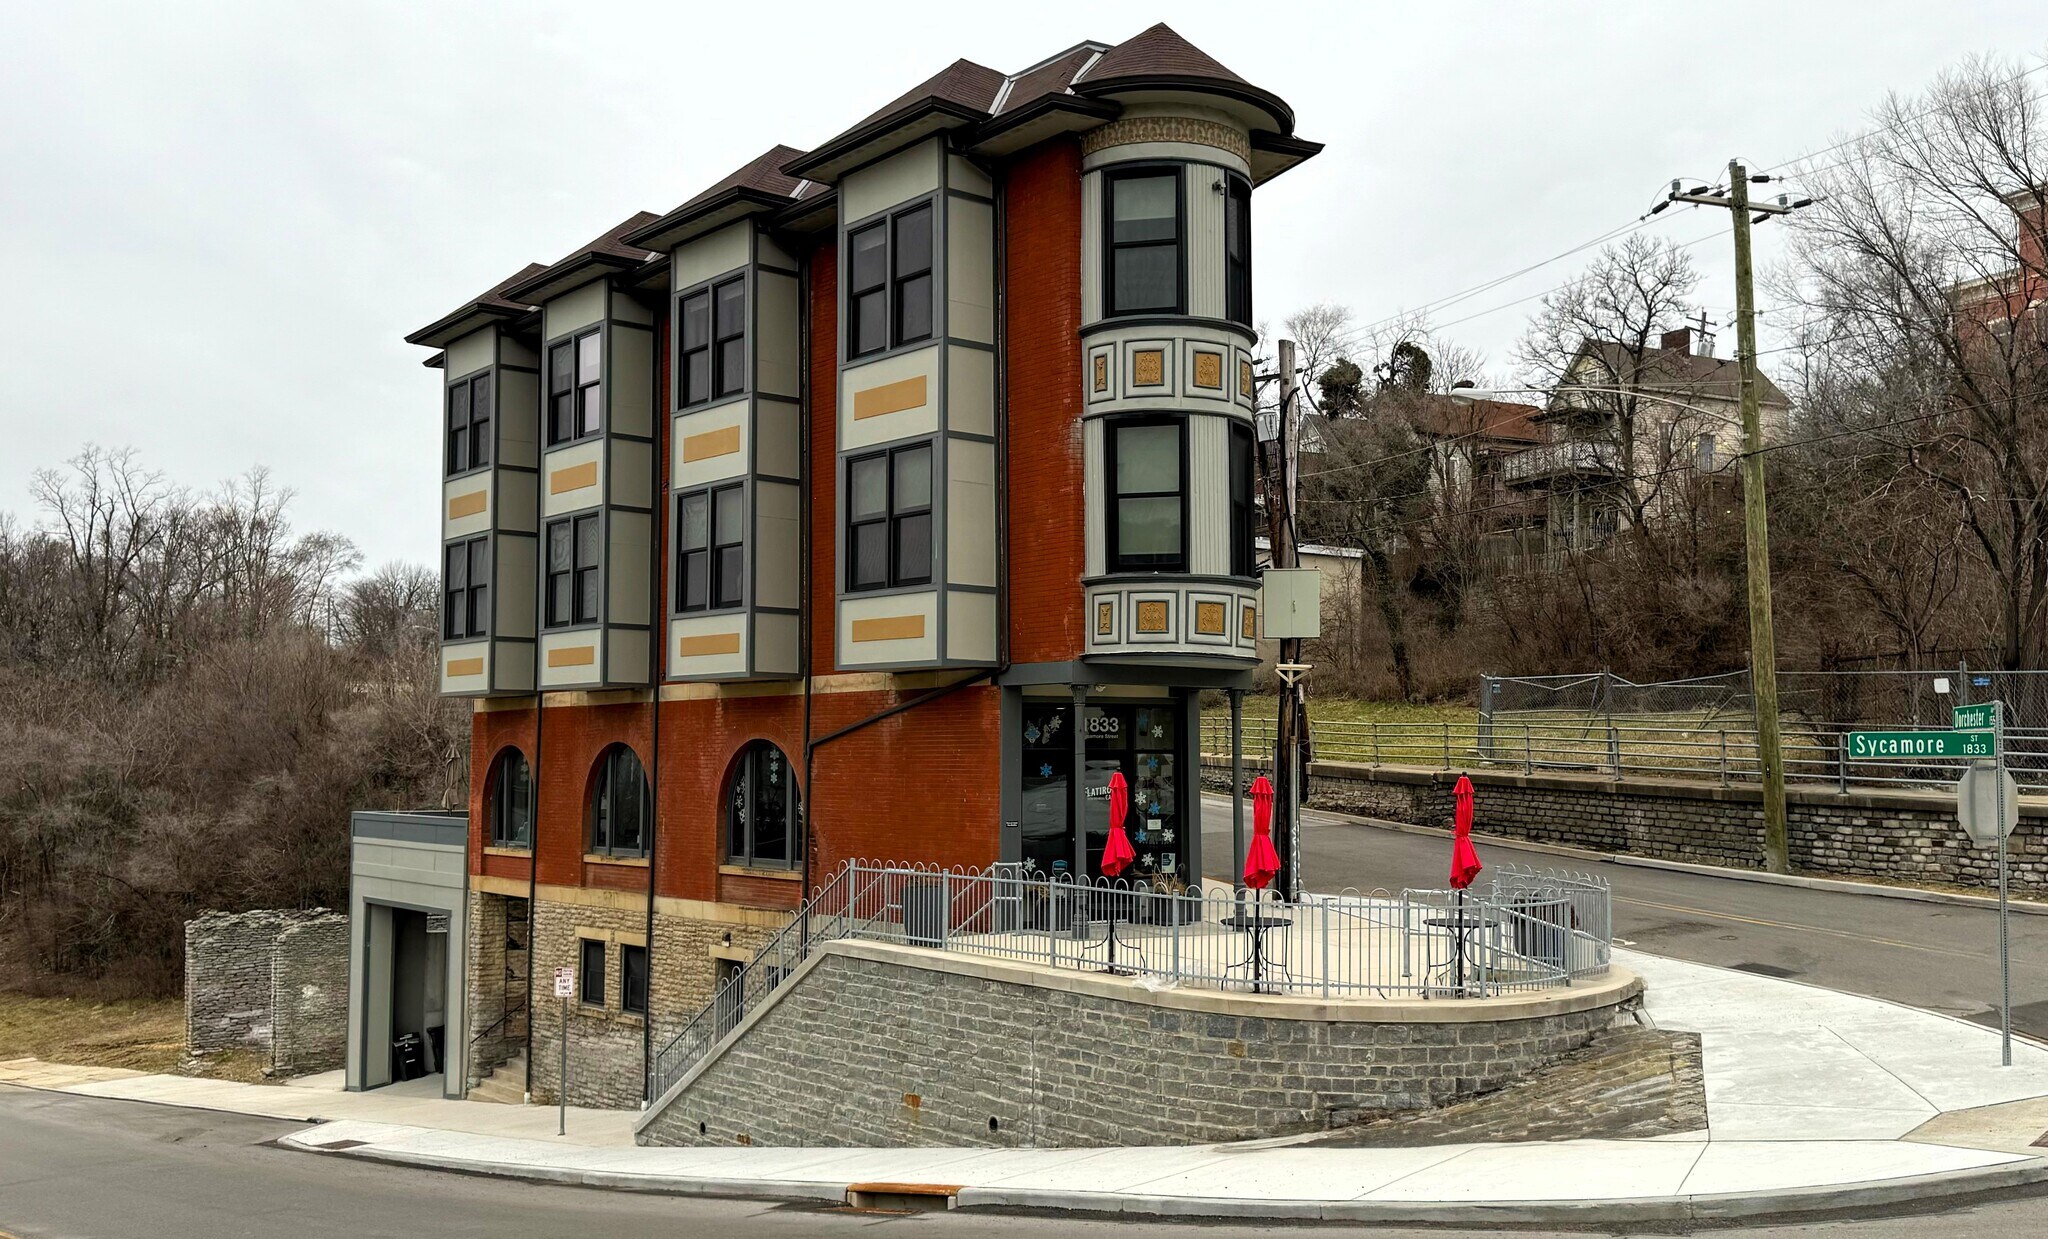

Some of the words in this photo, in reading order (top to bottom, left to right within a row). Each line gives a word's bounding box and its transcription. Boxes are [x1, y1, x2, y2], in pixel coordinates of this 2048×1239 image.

[1954, 708, 1985, 728] Dorchester
[1970, 734, 1979, 742] ST
[1856, 735, 1944, 757] Sycamore
[1963, 744, 1987, 754] 1833
